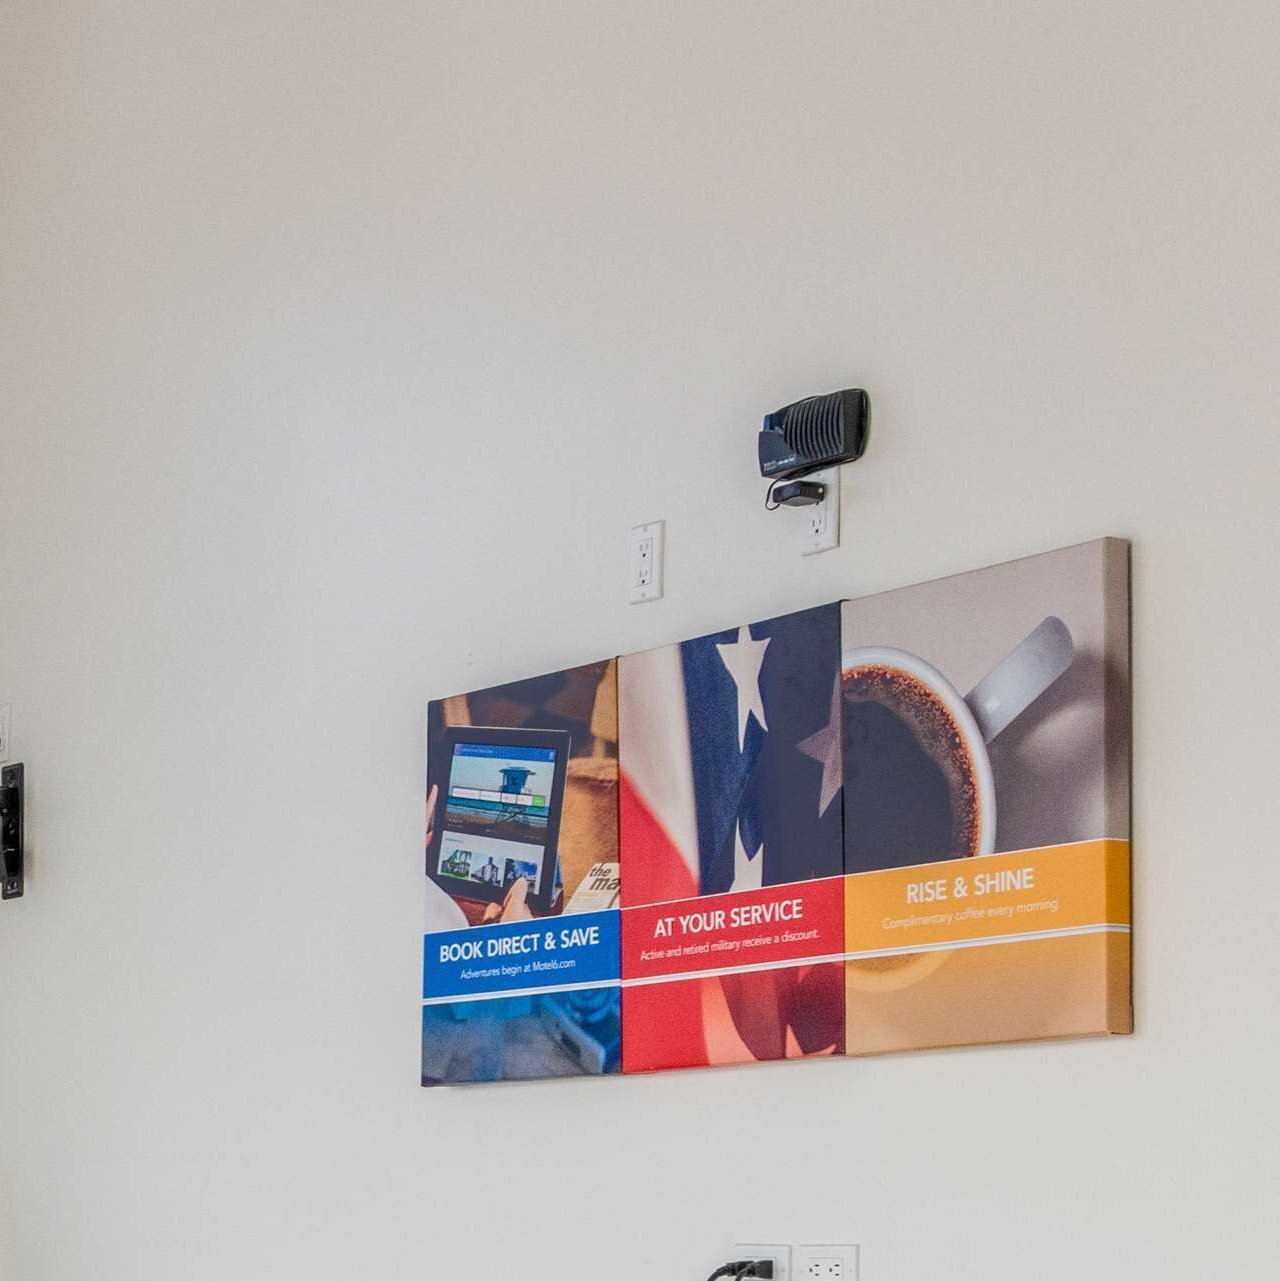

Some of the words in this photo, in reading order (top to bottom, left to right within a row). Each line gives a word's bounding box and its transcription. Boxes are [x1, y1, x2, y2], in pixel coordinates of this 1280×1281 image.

[906, 880, 947, 904] RISE
[953, 877, 968, 898] &
[974, 867, 1034, 896] SHINE
[653, 917, 675, 938] AT
[678, 911, 726, 934] YOUR
[730, 899, 803, 928] SERVICE
[882, 911, 954, 931] Complimentary
[955, 907, 986, 921] coffee
[987, 905, 1015, 918] every
[439, 940, 484, 963] BOOK
[487, 934, 541, 957] DIRECT
[544, 932, 556, 950] &
[560, 926, 600, 949] SAVE
[640, 949, 665, 961] Active
[665, 946, 682, 957] and
[682, 942, 710, 955] retired
[711, 939, 741, 953] military
[742, 935, 773, 948] receive
[460, 965, 501, 980] Adventures
[501, 965, 523, 978] begin
[523, 964, 532, 973] at
[532, 959, 576, 972] Motel6.com
